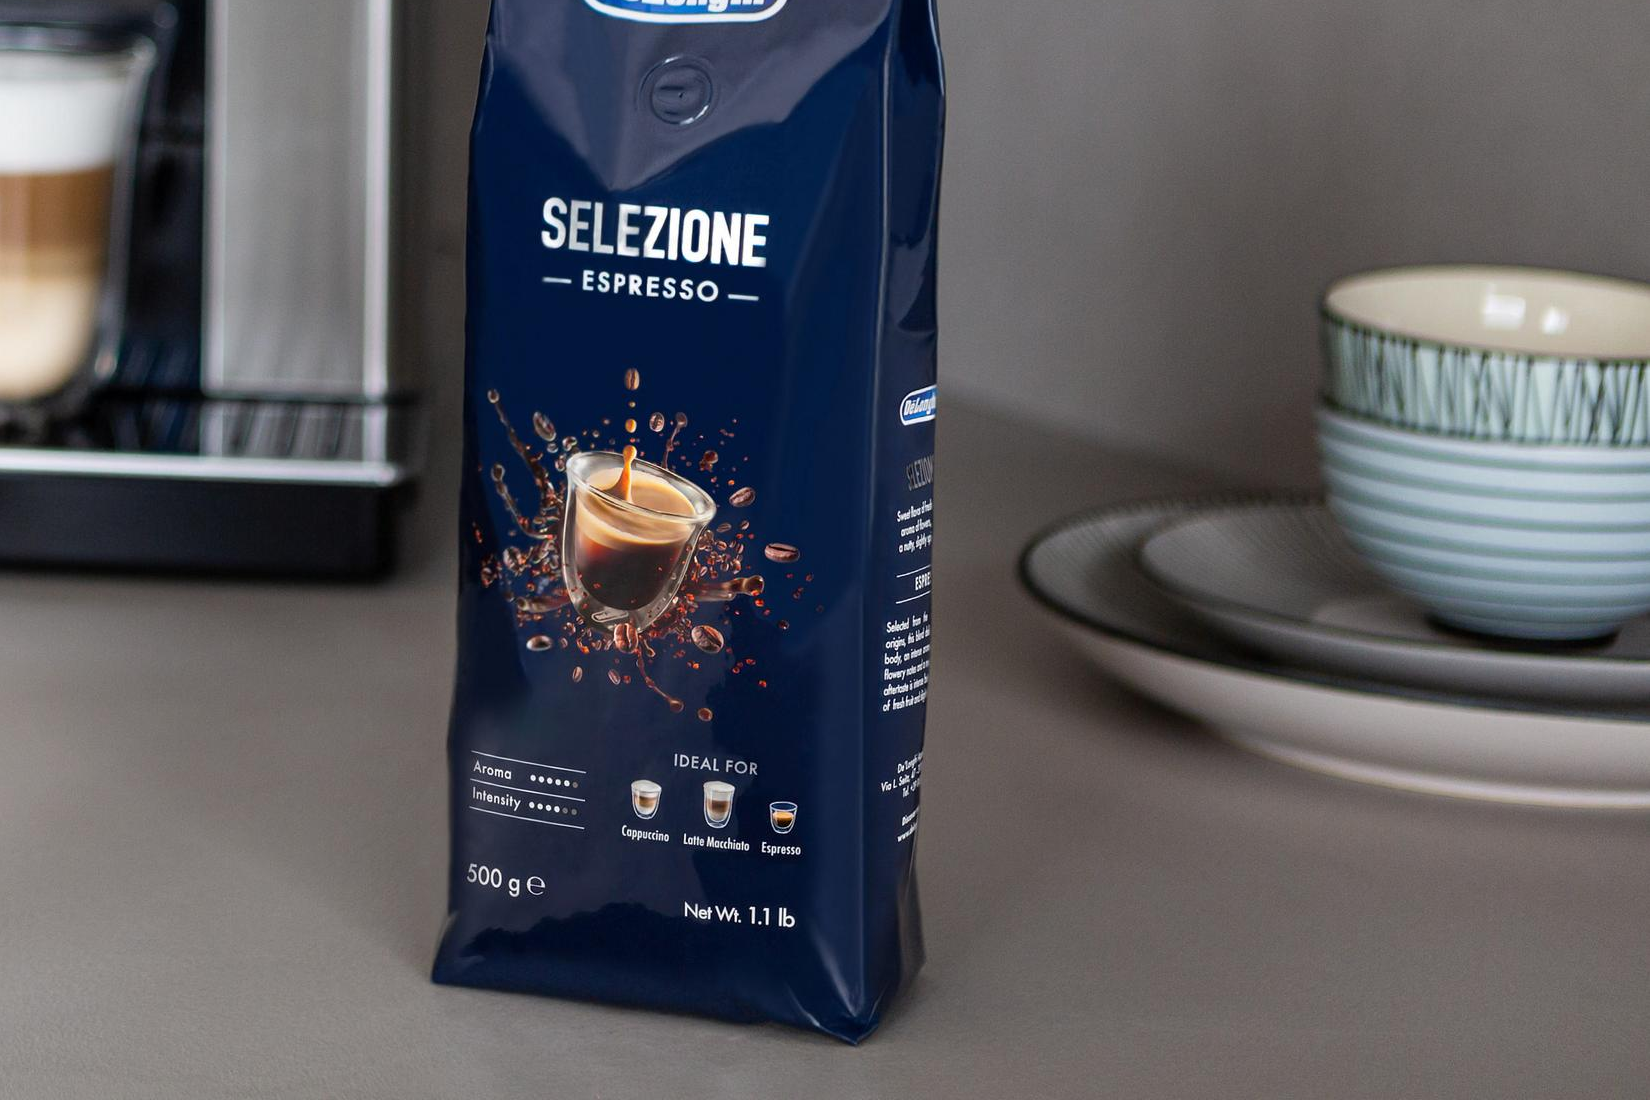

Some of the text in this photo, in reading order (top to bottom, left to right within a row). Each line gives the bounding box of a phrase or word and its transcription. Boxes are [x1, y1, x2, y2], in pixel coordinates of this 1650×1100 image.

[541, 197, 769, 268] SELEZIONE
[582, 269, 719, 302] ESPRESSO
[886, 616, 910, 633] Selected
[884, 652, 902, 666] body,
[884, 667, 907, 681] flowery
[882, 698, 891, 712] of
[473, 760, 512, 780] Aroma
[674, 753, 759, 775] IDEAL FOR
[880, 781, 892, 793] Via
[472, 786, 521, 812] Intensity
[621, 824, 670, 843] Cappuccino
[683, 833, 750, 852] Latte Macchiato
[761, 841, 802, 857] Espresso
[466, 862, 503, 889] 500
[508, 877, 520, 898] g
[683, 901, 796, 928] Net Wt. 1.1 lb
